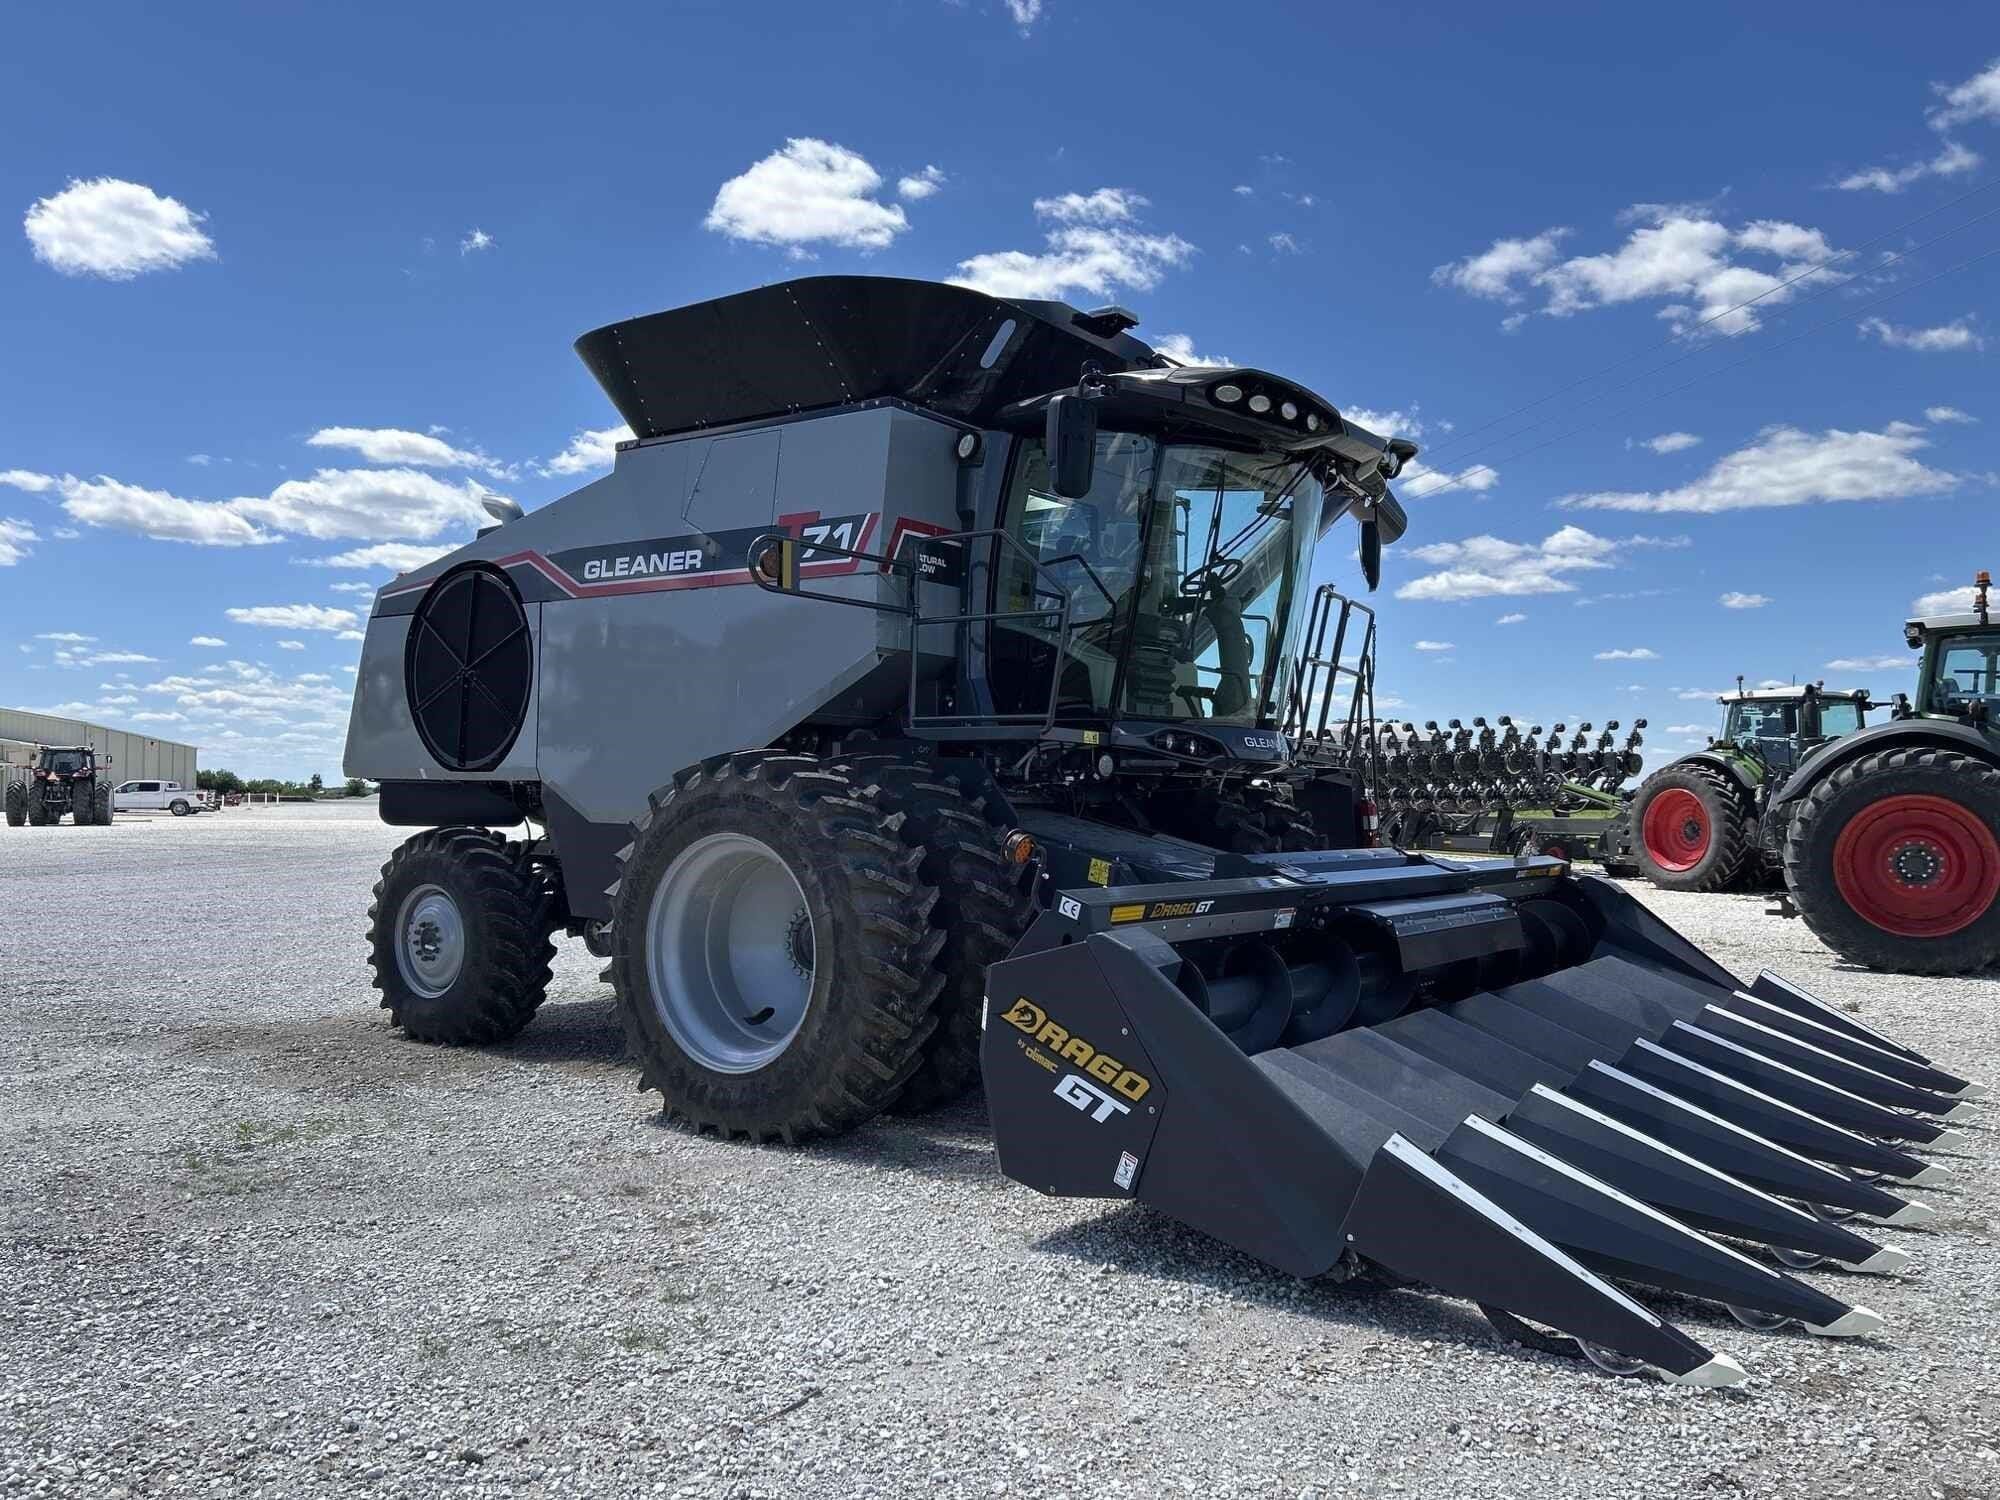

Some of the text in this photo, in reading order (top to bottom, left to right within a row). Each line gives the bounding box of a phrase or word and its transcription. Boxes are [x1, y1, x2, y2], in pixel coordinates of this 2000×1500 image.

[584, 549, 703, 580] GLEANER
[1150, 900, 1215, 918] DRAGO GT
[1000, 998, 1151, 1102] DRAGO
[1053, 1074, 1131, 1124] GT
